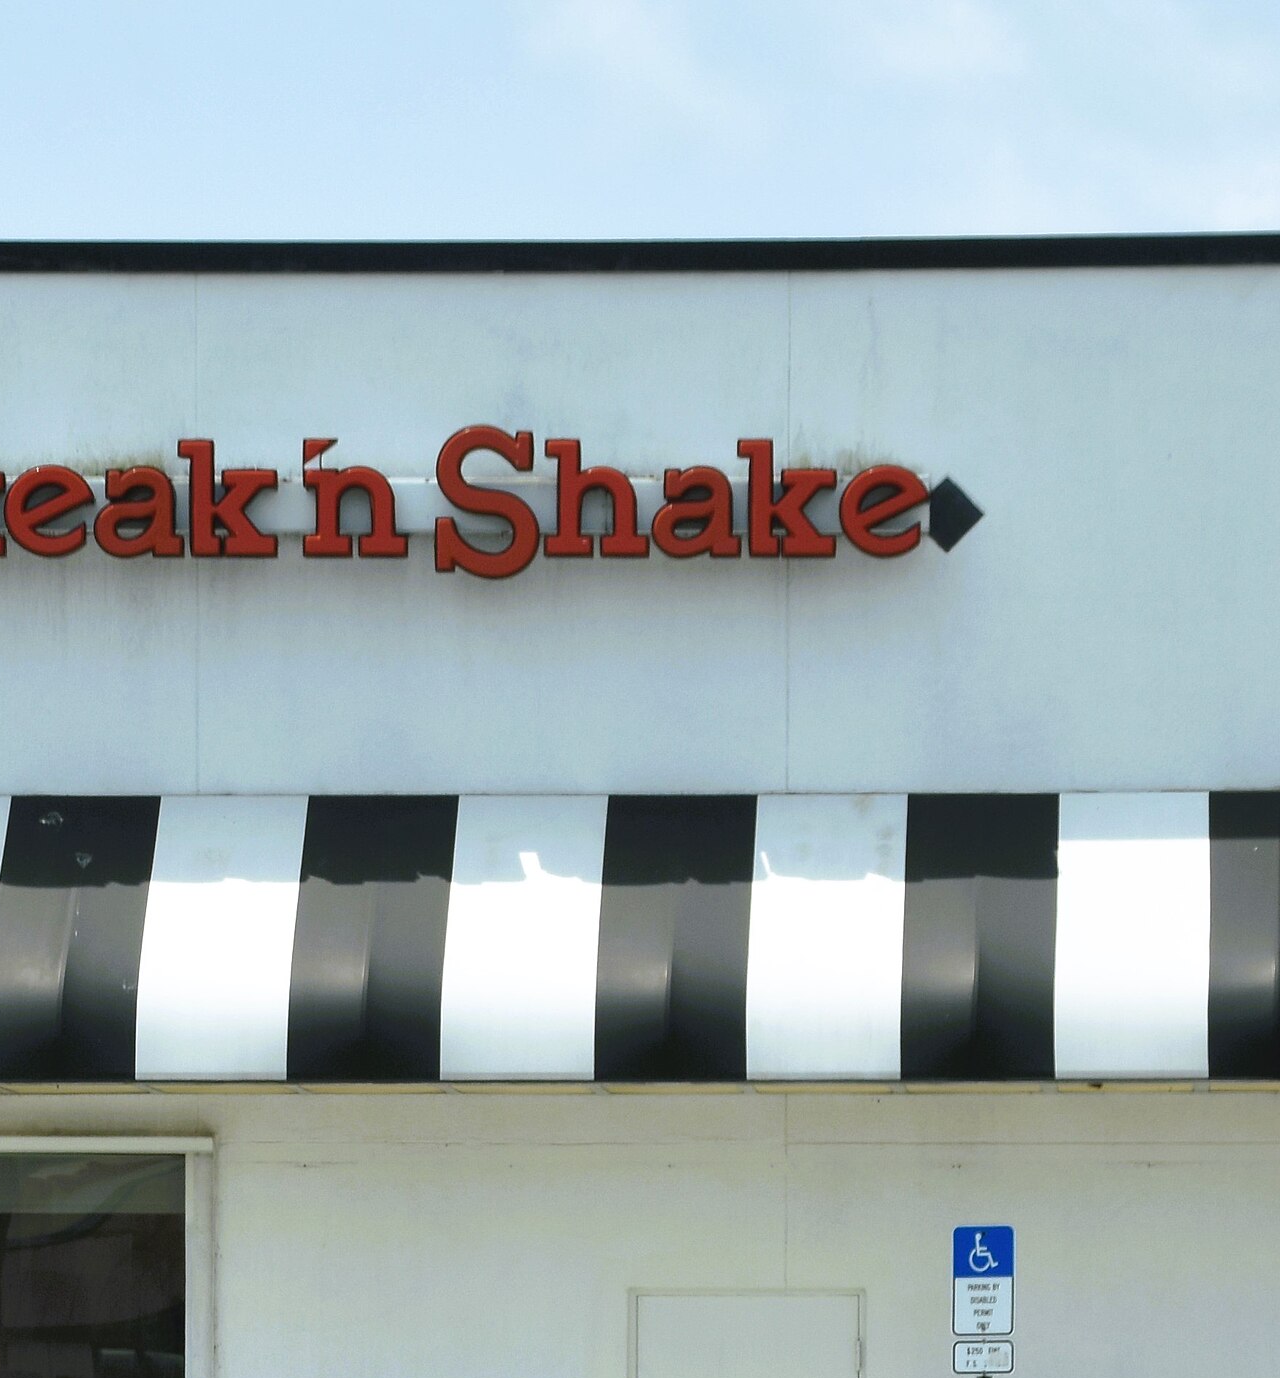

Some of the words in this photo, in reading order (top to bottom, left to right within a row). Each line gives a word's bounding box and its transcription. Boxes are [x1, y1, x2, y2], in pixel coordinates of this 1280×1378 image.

[434, 423, 930, 579] Shake
[967, 1283, 991, 1292] PARKING
[970, 1296, 997, 1304] DISABLED
